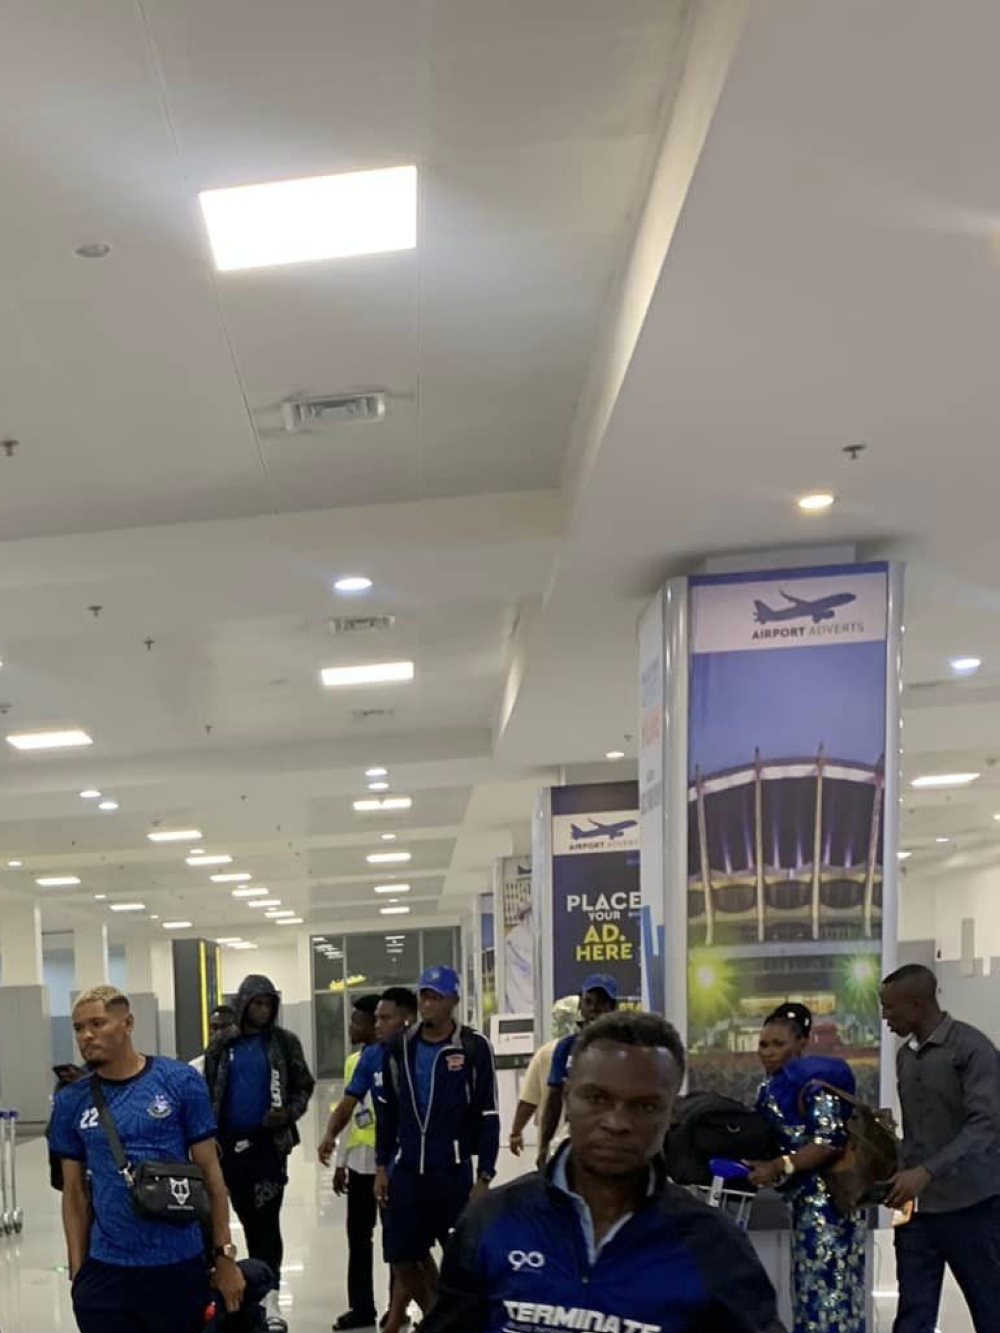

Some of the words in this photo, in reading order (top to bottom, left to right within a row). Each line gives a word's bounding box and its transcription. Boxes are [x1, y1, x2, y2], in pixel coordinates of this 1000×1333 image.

[752, 627, 804, 639] AIRPORT
[809, 623, 864, 635] ADVERTS
[567, 892, 642, 912] PLACE
[589, 912, 620, 920] YOUR
[584, 923, 625, 943] AD.
[576, 943, 632, 961] HERE
[80, 1107, 98, 1129] 22
[508, 1250, 544, 1271] 90
